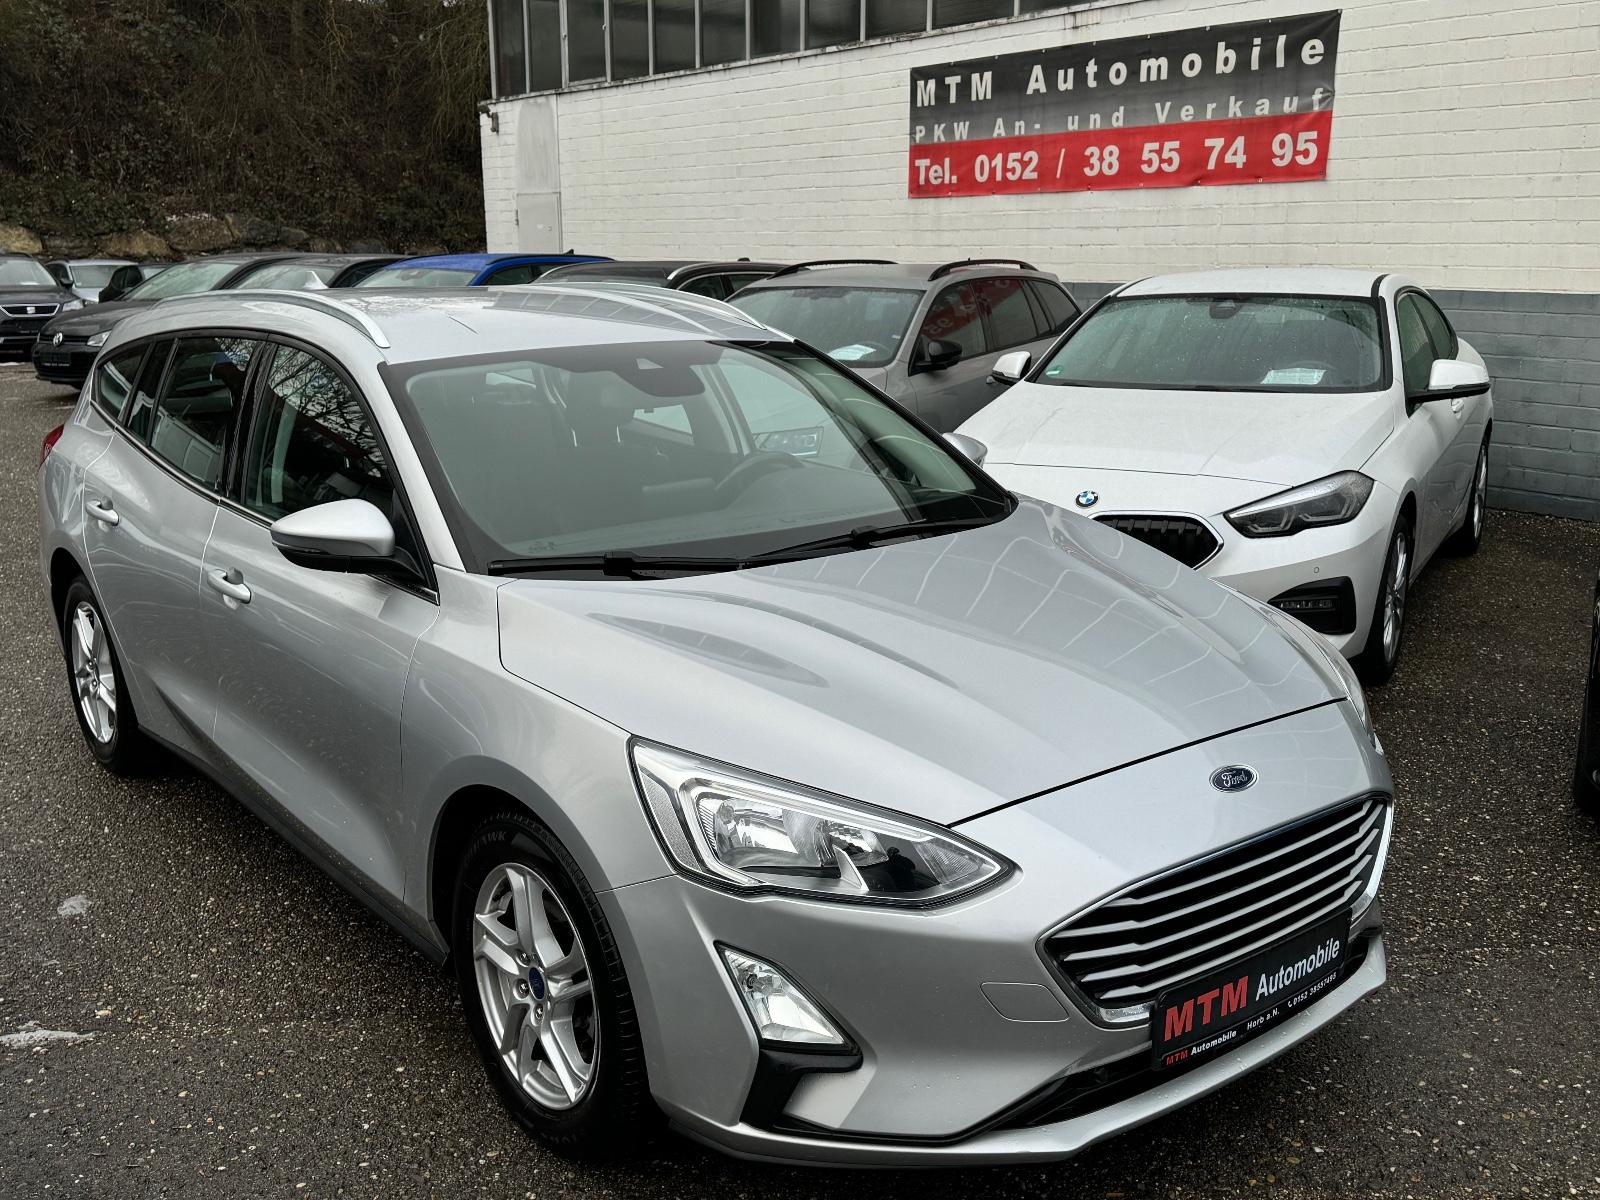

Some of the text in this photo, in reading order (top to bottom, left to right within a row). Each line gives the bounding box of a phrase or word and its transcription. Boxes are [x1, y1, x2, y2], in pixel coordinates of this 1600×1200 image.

[916, 34, 1325, 107] MTM Automobile
[915, 87, 1324, 144] PKW An- und Verkauf
[915, 131, 1319, 185] Tel. 0152 / 38 55 74 95
[1221, 770, 1248, 787] Ford
[1164, 937, 1340, 1041] MTM Automobile
[1166, 1048, 1188, 1066] MTM
[1190, 1029, 1237, 1056] Automobile
[1247, 1015, 1265, 1031] Horb
